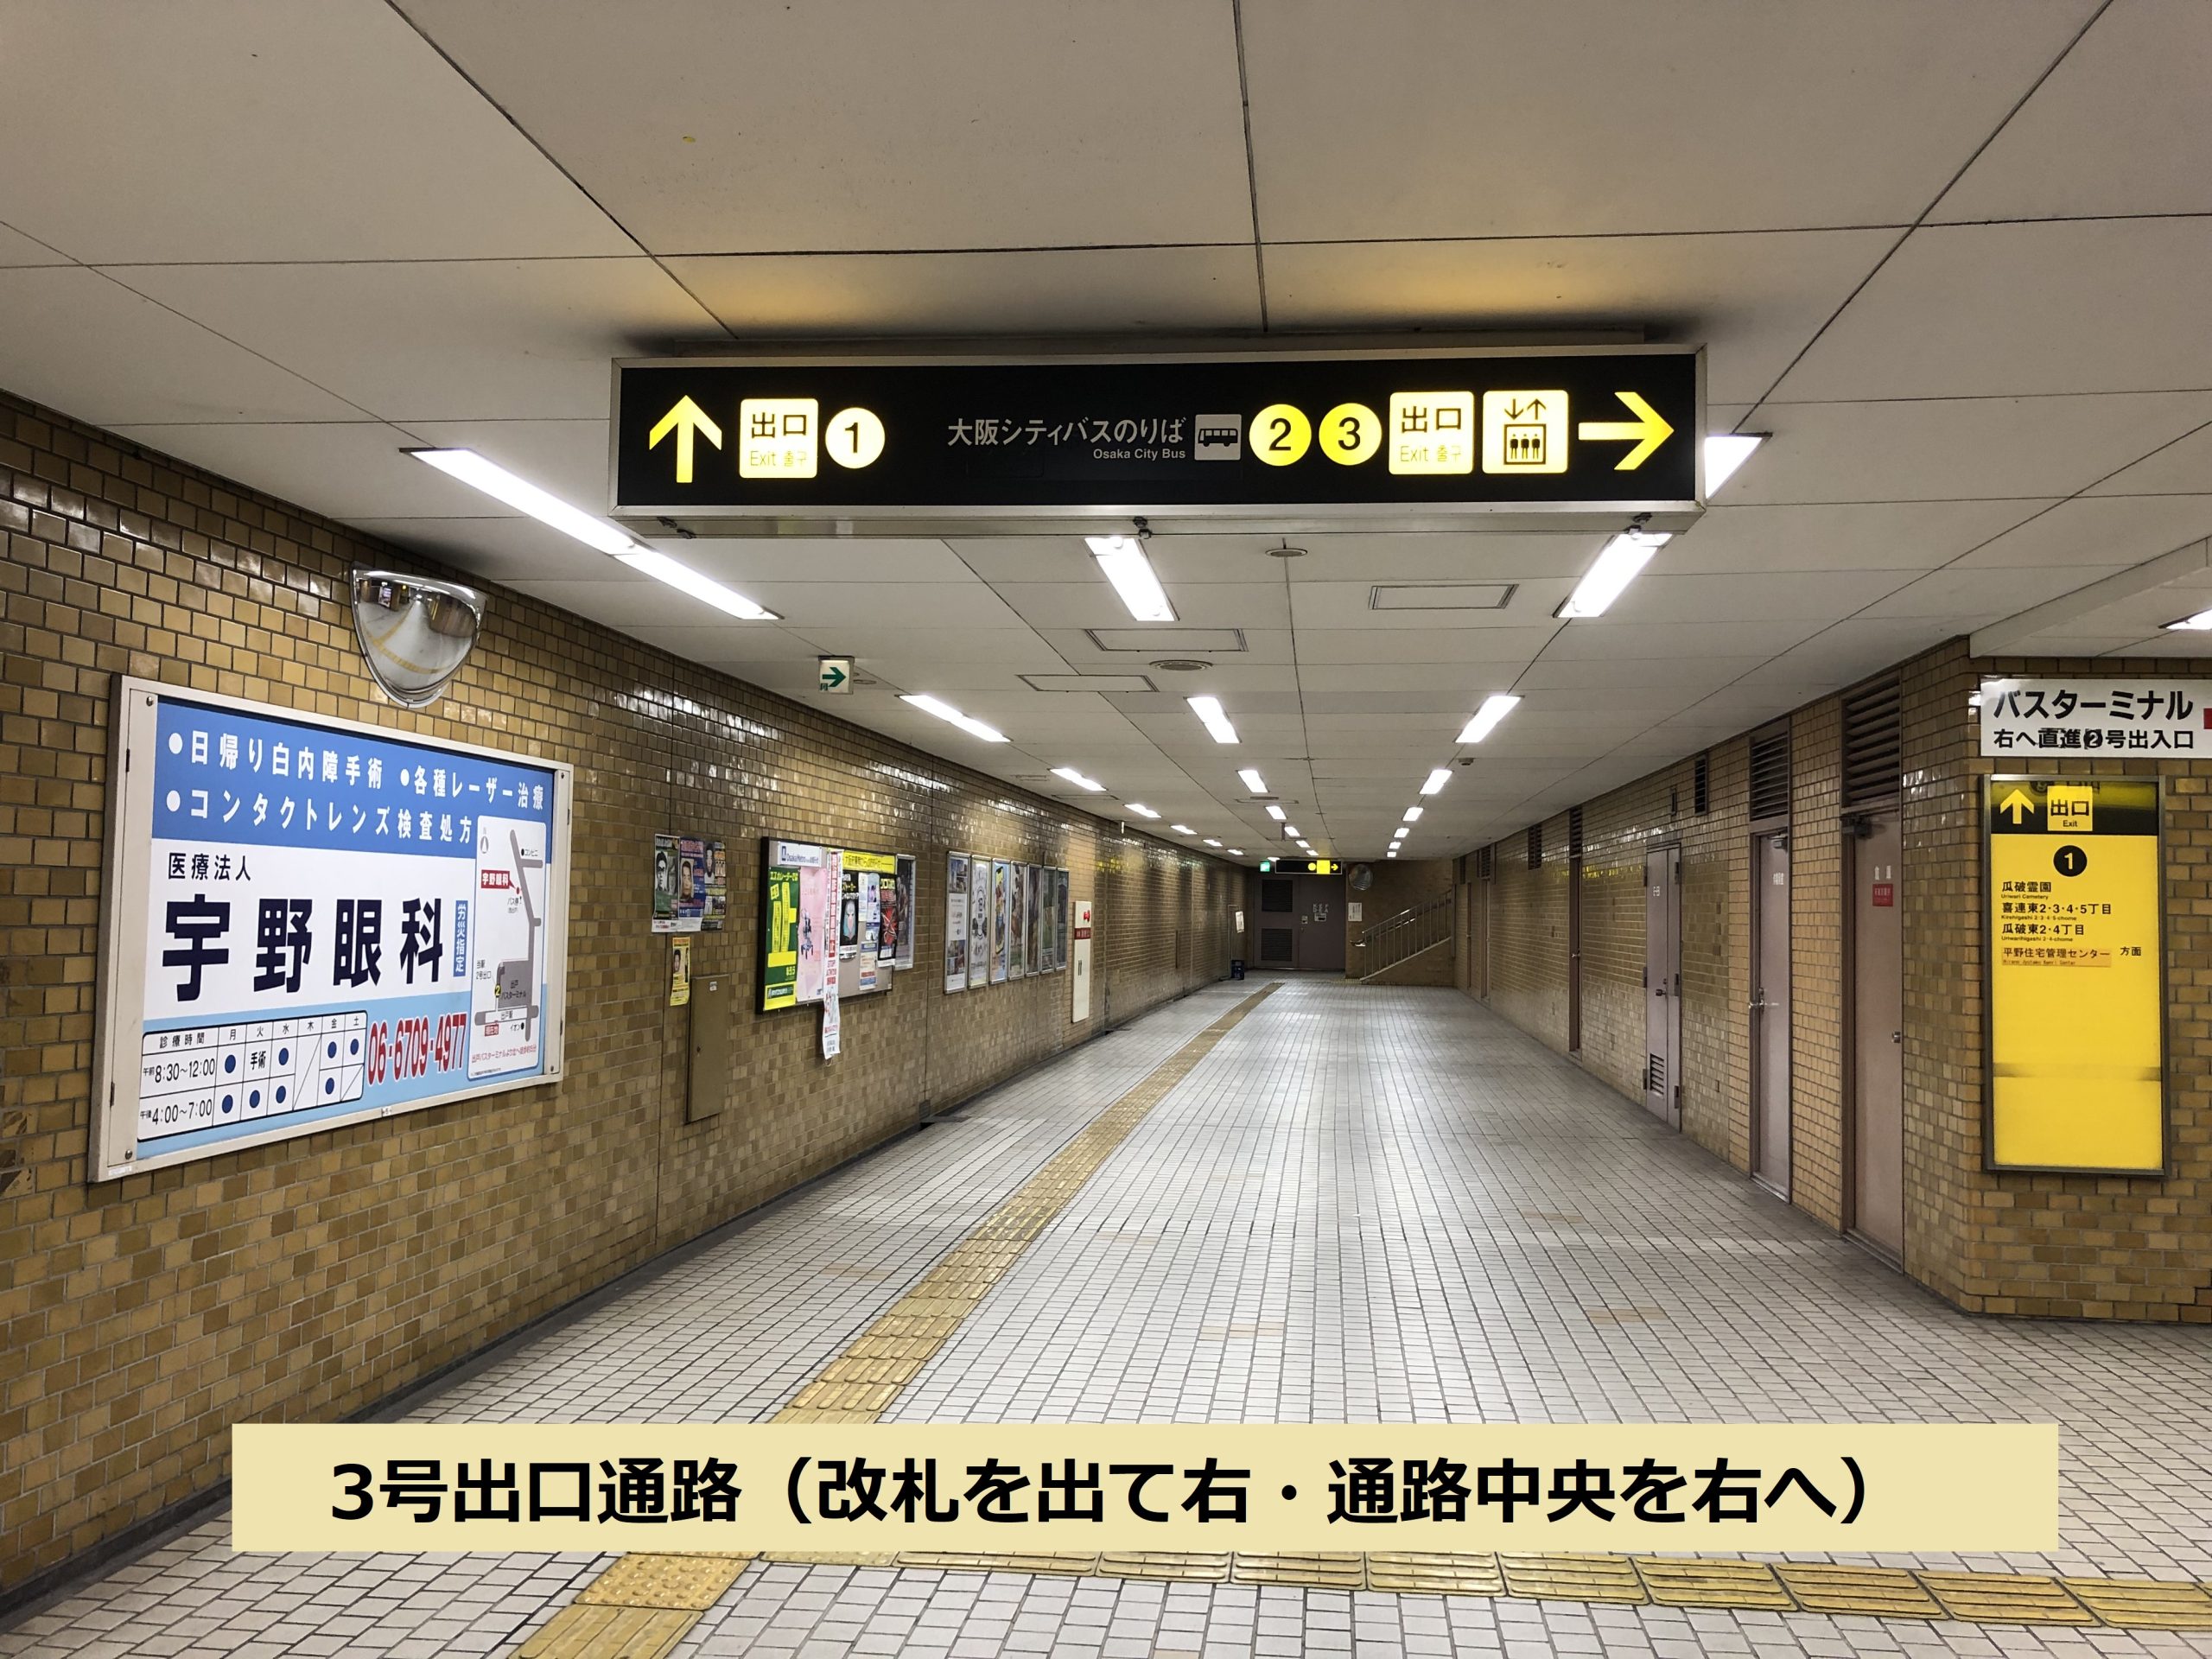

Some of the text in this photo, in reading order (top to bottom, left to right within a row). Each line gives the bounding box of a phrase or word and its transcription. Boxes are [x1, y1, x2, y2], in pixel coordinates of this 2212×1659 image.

[752, 411, 808, 438] 出口
[948, 416, 1187, 447] 大阪シティバスのりば
[1268, 416, 1362, 452] 2 3
[1402, 405, 1462, 434] 出口
[846, 422, 860, 454] 1
[751, 450, 776, 466] Exit
[1093, 448, 1186, 461] Osaka City Bus
[1400, 445, 1429, 463] Exit
[1993, 689, 2194, 721] バスターミナル
[414, 764, 544, 811] 各種レーザー治療
[189, 788, 474, 844] コンタクトレンズ検査処方
[2050, 798, 2089, 816] 出口
[168, 851, 251, 881] 医療法人
[2063, 852, 2074, 870] 1
[2002, 881, 2052, 893] 瓜破霊園
[162, 893, 444, 1002] 宇野眼科
[455, 903, 467, 974] 労災指定
[2003, 947, 2111, 959] 平野住宅管理センター
[2120, 947, 2142, 957] 方面
[159, 1015, 359, 1049] 診療時間 月 火 水 木 金 土
[250, 1051, 267, 1071] 手術
